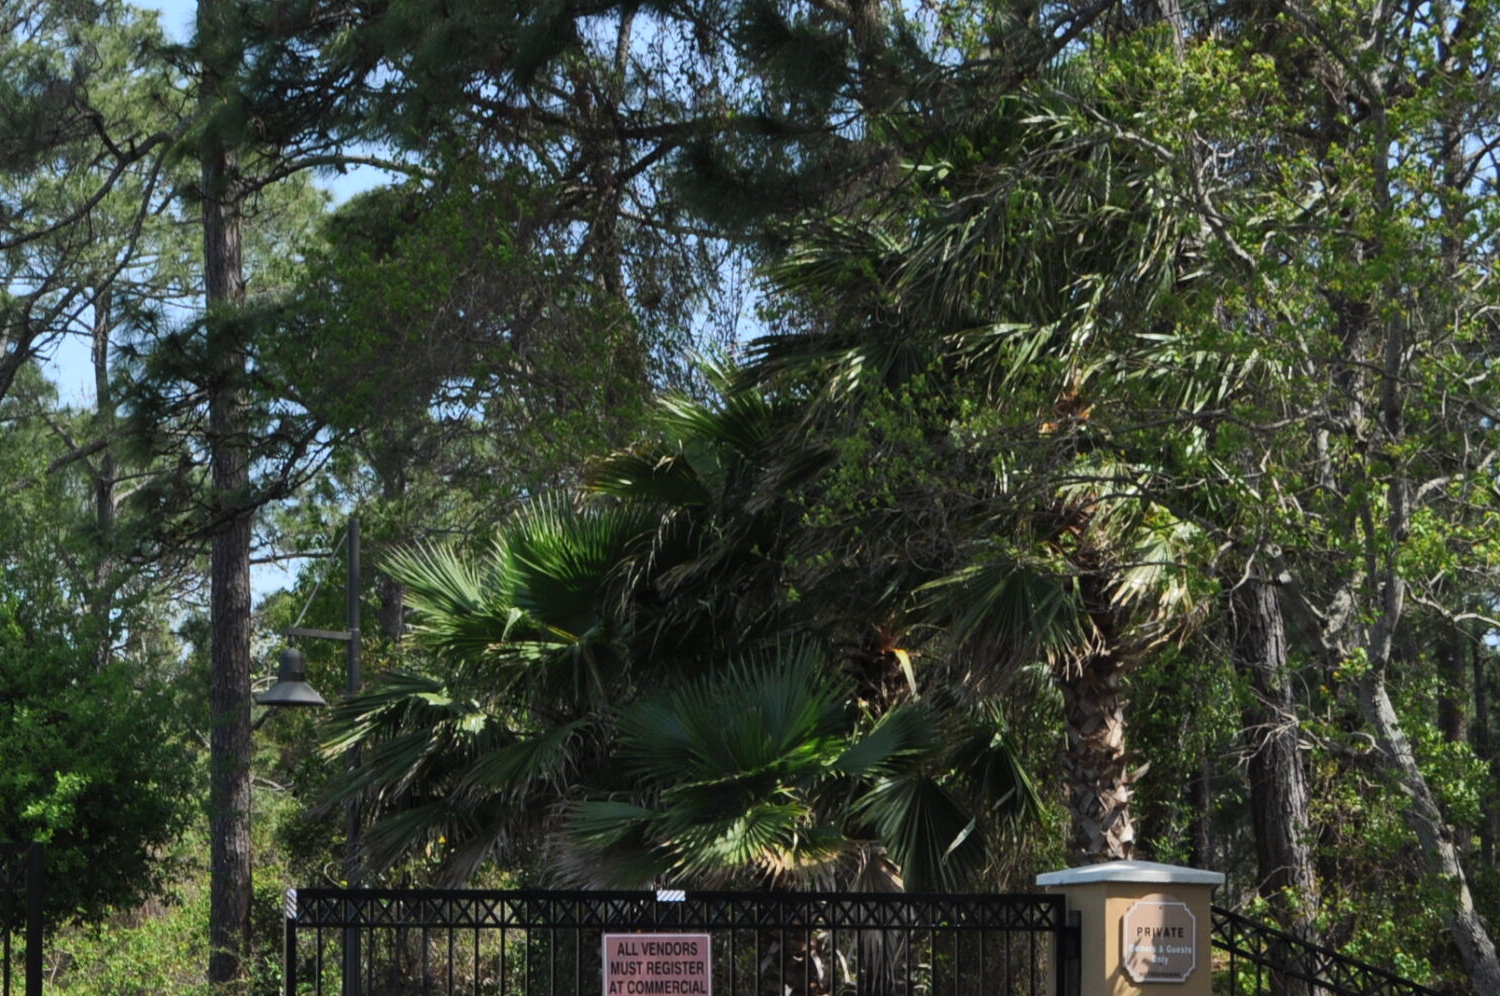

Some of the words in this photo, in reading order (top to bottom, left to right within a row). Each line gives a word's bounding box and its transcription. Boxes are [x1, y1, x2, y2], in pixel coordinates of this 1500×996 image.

[1137, 927, 1184, 938] PRIVATE
[617, 942, 638, 956] ALL
[641, 942, 698, 956] VENDORS
[1166, 944, 1192, 954] Guests
[611, 961, 643, 975] MUST
[647, 961, 704, 975] REGISTER
[609, 981, 623, 994] AT
[627, 981, 707, 994] COMMERCIAL
